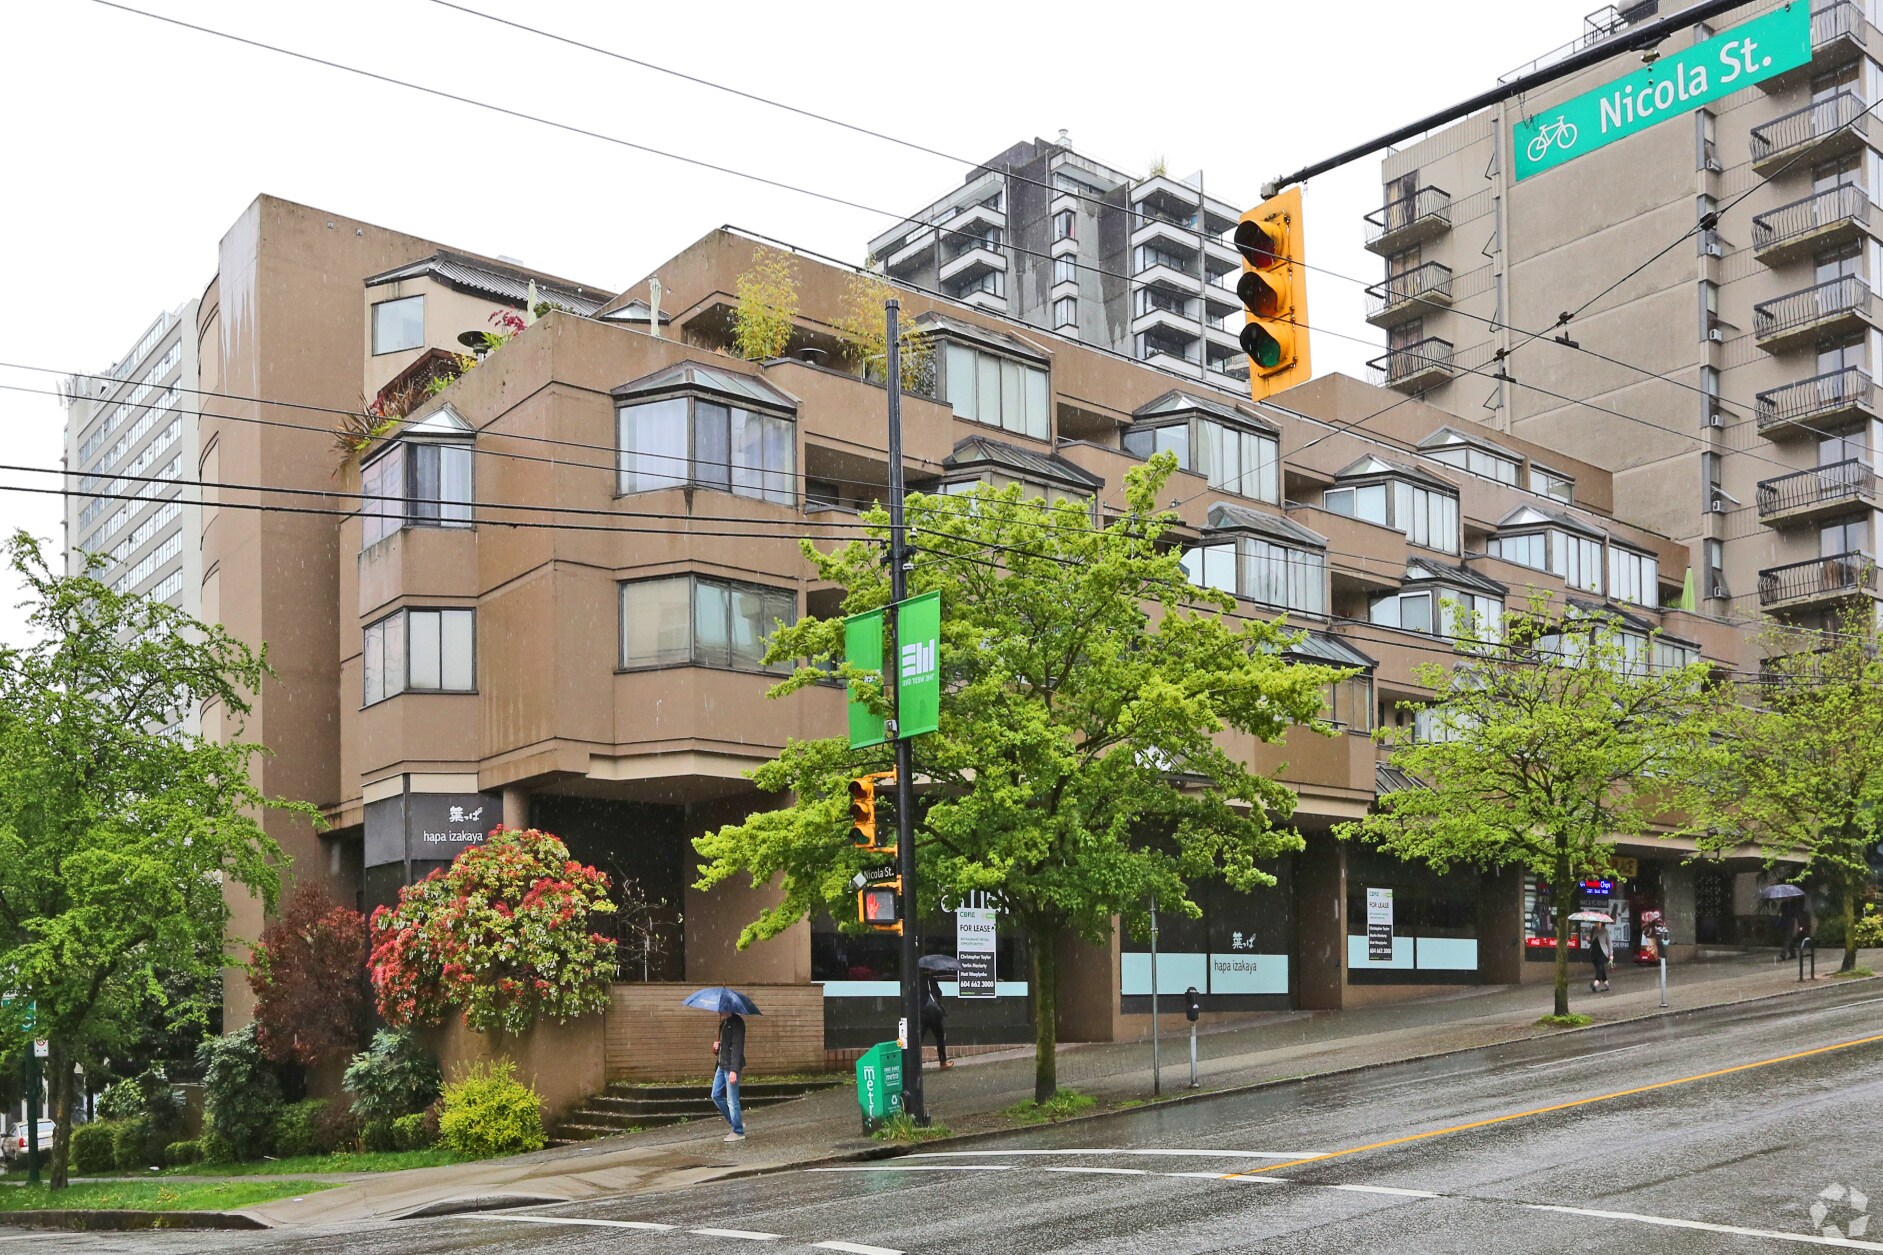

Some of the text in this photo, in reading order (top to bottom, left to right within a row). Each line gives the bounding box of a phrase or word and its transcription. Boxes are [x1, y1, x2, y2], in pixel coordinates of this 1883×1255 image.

[1600, 37, 1772, 134] Nicola St.
[423, 830, 484, 845] hapa izakaya
[864, 866, 894, 880] Nicola St.
[974, 924, 990, 933] LEASE
[1214, 960, 1257, 974] hapa izakaya
[863, 1068, 875, 1128] metr
